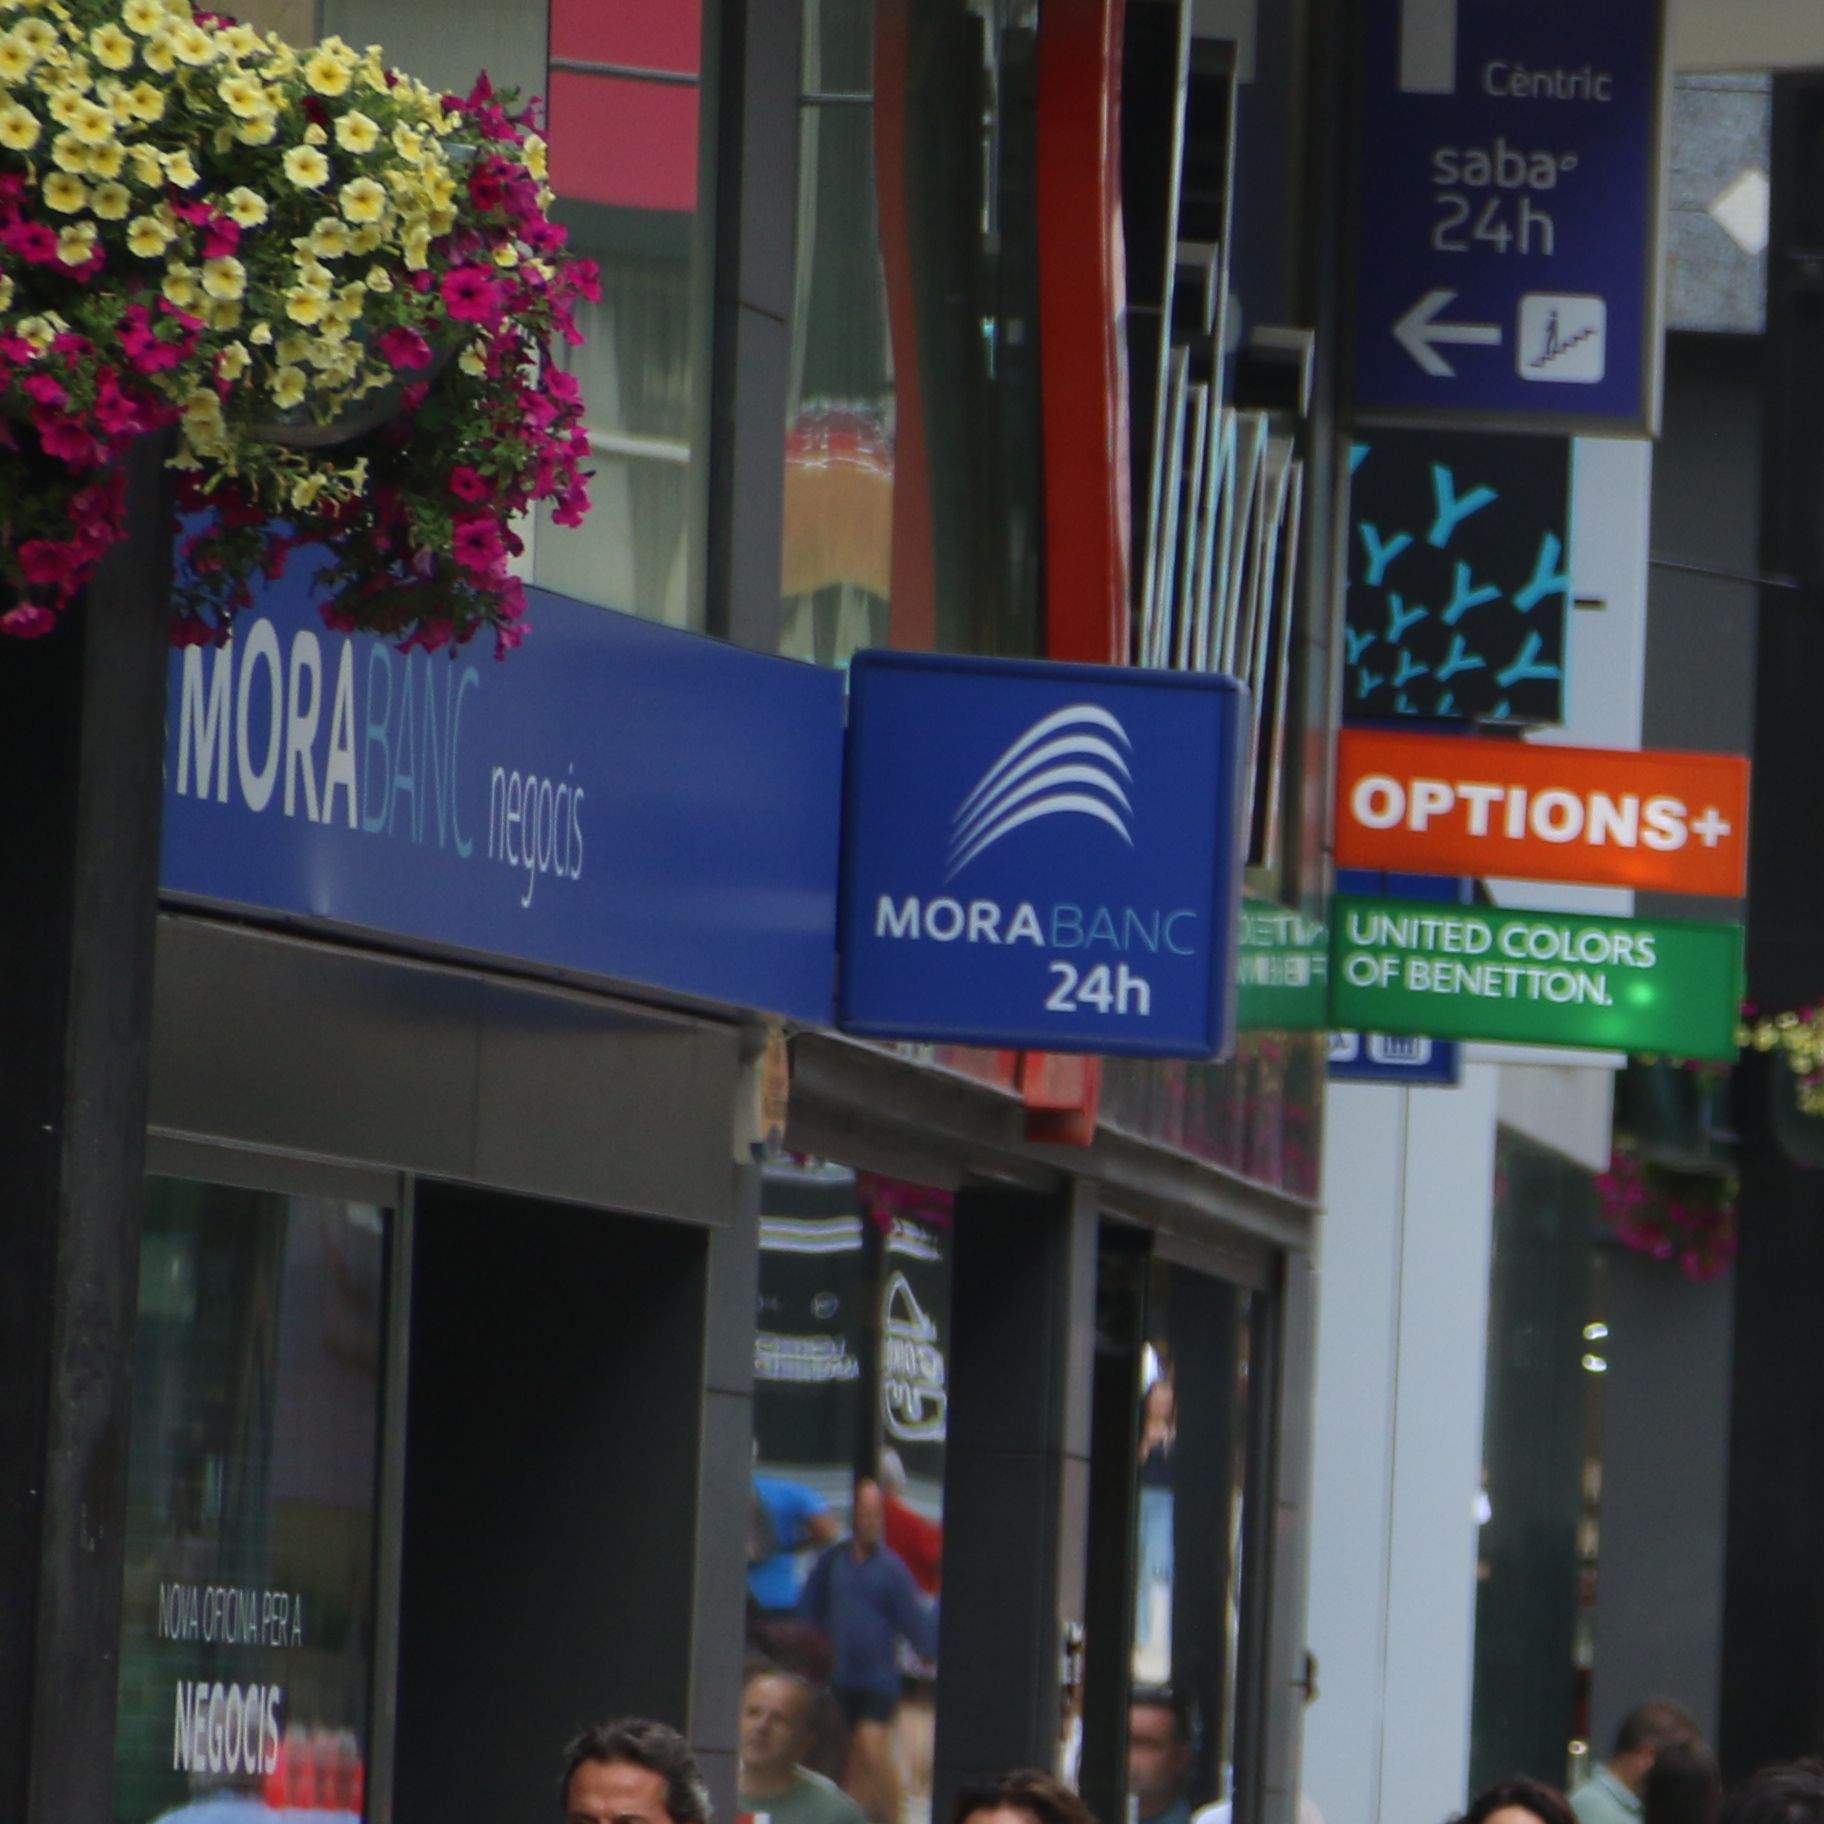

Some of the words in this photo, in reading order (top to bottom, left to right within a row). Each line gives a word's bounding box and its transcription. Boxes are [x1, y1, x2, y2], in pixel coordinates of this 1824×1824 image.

[1482, 60, 1613, 103] Cèntric
[1430, 193, 1556, 257] 24h
[176, 617, 480, 859] MORABANC
[488, 762, 585, 909] negocis
[1350, 773, 1732, 852] OPTIONS+
[875, 893, 1199, 956] MORABANC
[1347, 912, 1492, 955] UNITED
[1499, 921, 1657, 968] COLORS
[1044, 959, 1152, 1017] 24h
[1344, 952, 1401, 989] OF
[158, 1581, 199, 1640] NOVA
[202, 1584, 257, 1644] OFICINA
[261, 1590, 290, 1648] PER
[291, 1593, 303, 1648] A
[173, 1679, 282, 1776] NEGOCIS
